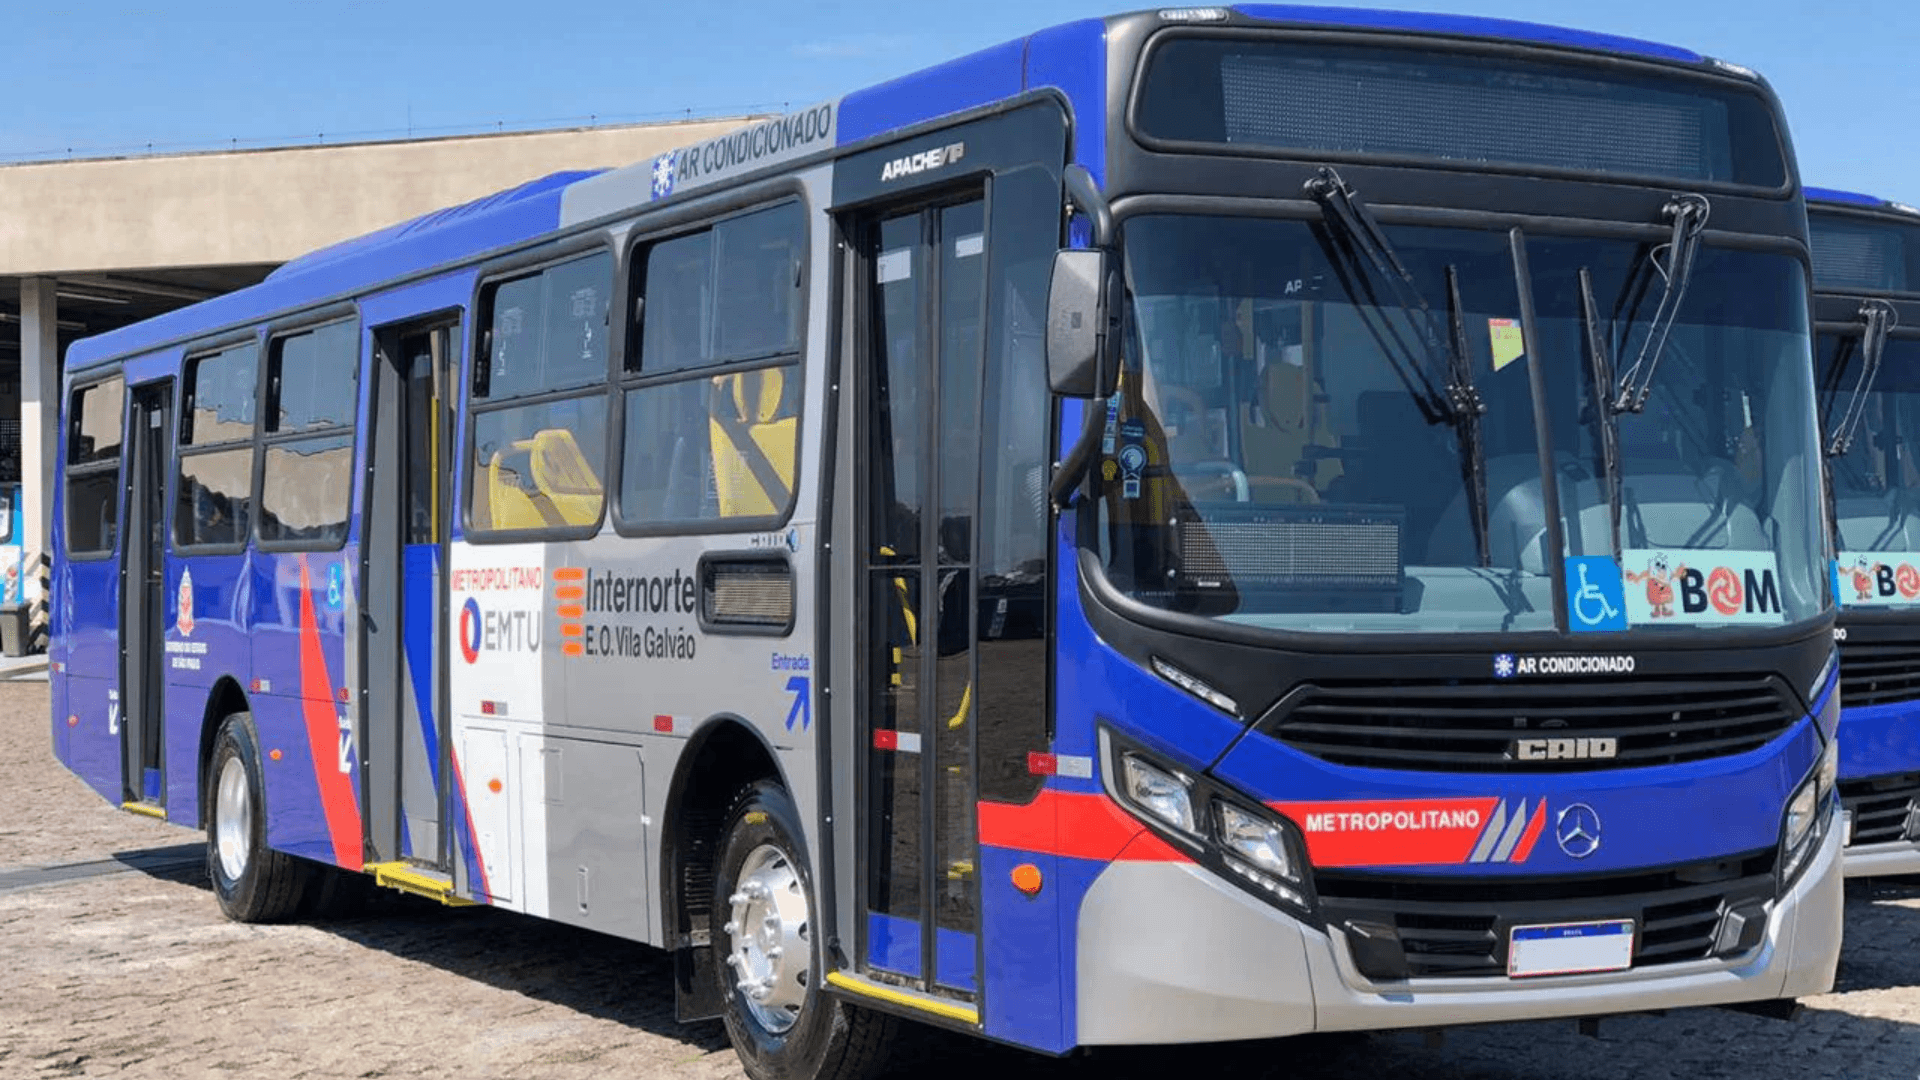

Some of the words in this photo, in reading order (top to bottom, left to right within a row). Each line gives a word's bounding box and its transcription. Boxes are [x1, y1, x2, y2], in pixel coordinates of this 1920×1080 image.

[677, 147, 700, 182] AR
[703, 103, 832, 174] CONDICIONADO
[586, 567, 696, 614] Internorte
[1679, 566, 1781, 615] BOM
[484, 610, 541, 653] EMTU
[616, 625, 641, 658] Vila
[771, 652, 810, 671] Entrada
[1517, 656, 1537, 674] AR
[1539, 655, 1635, 674] CONDICIONADO
[1517, 738, 1617, 760] CAIO
[1305, 809, 1480, 833] METROPOLITANO
